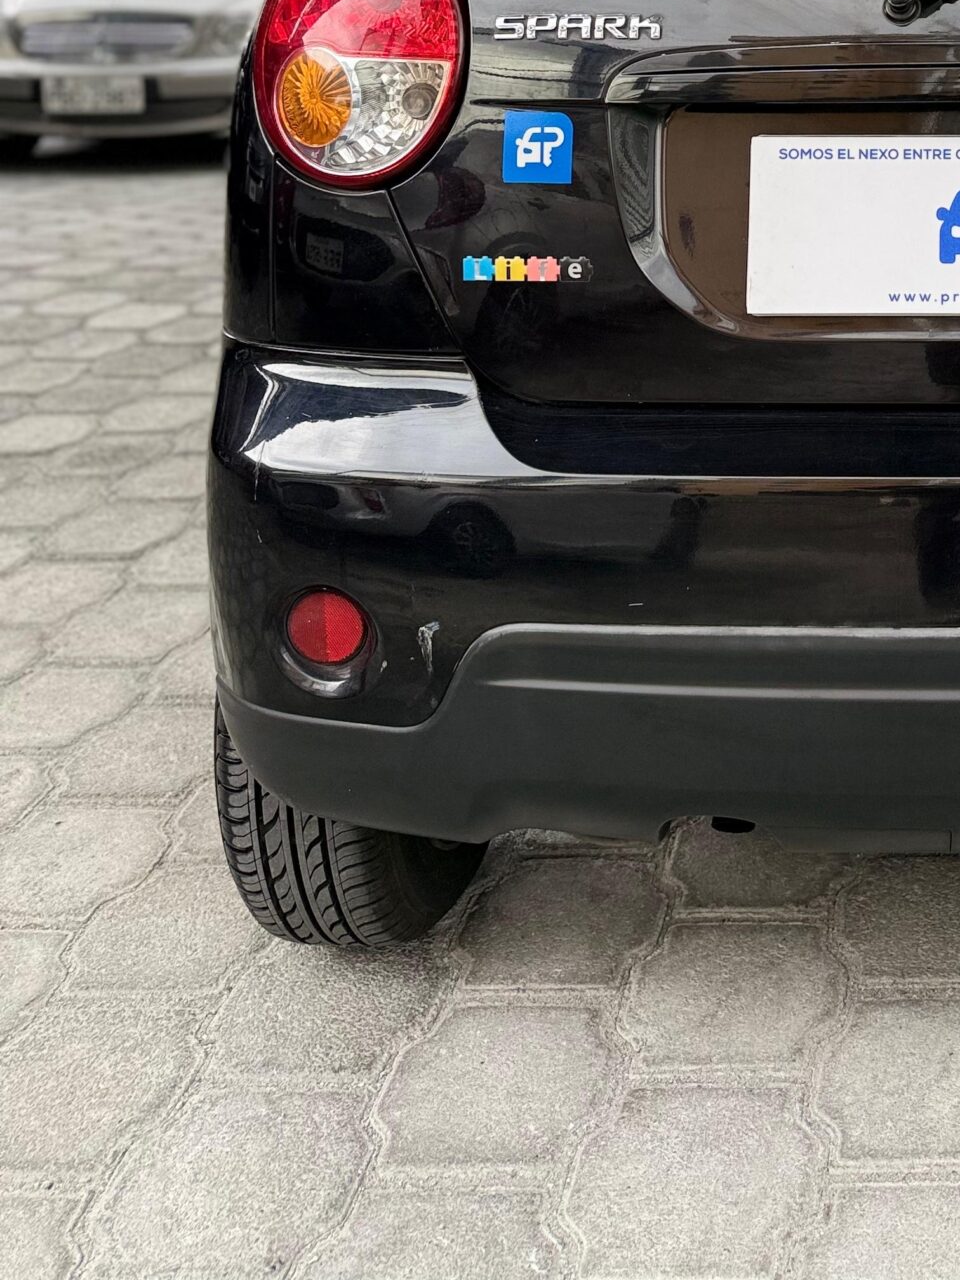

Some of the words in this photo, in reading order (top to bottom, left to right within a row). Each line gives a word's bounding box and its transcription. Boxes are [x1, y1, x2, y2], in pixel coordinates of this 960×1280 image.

[494, 12, 663, 39] SPARK
[778, 148, 834, 160] SOMOS
[837, 148, 855, 160] EL
[858, 148, 899, 160] NEXO
[903, 148, 951, 160] ENTRE
[472, 260, 585, 281] Life
